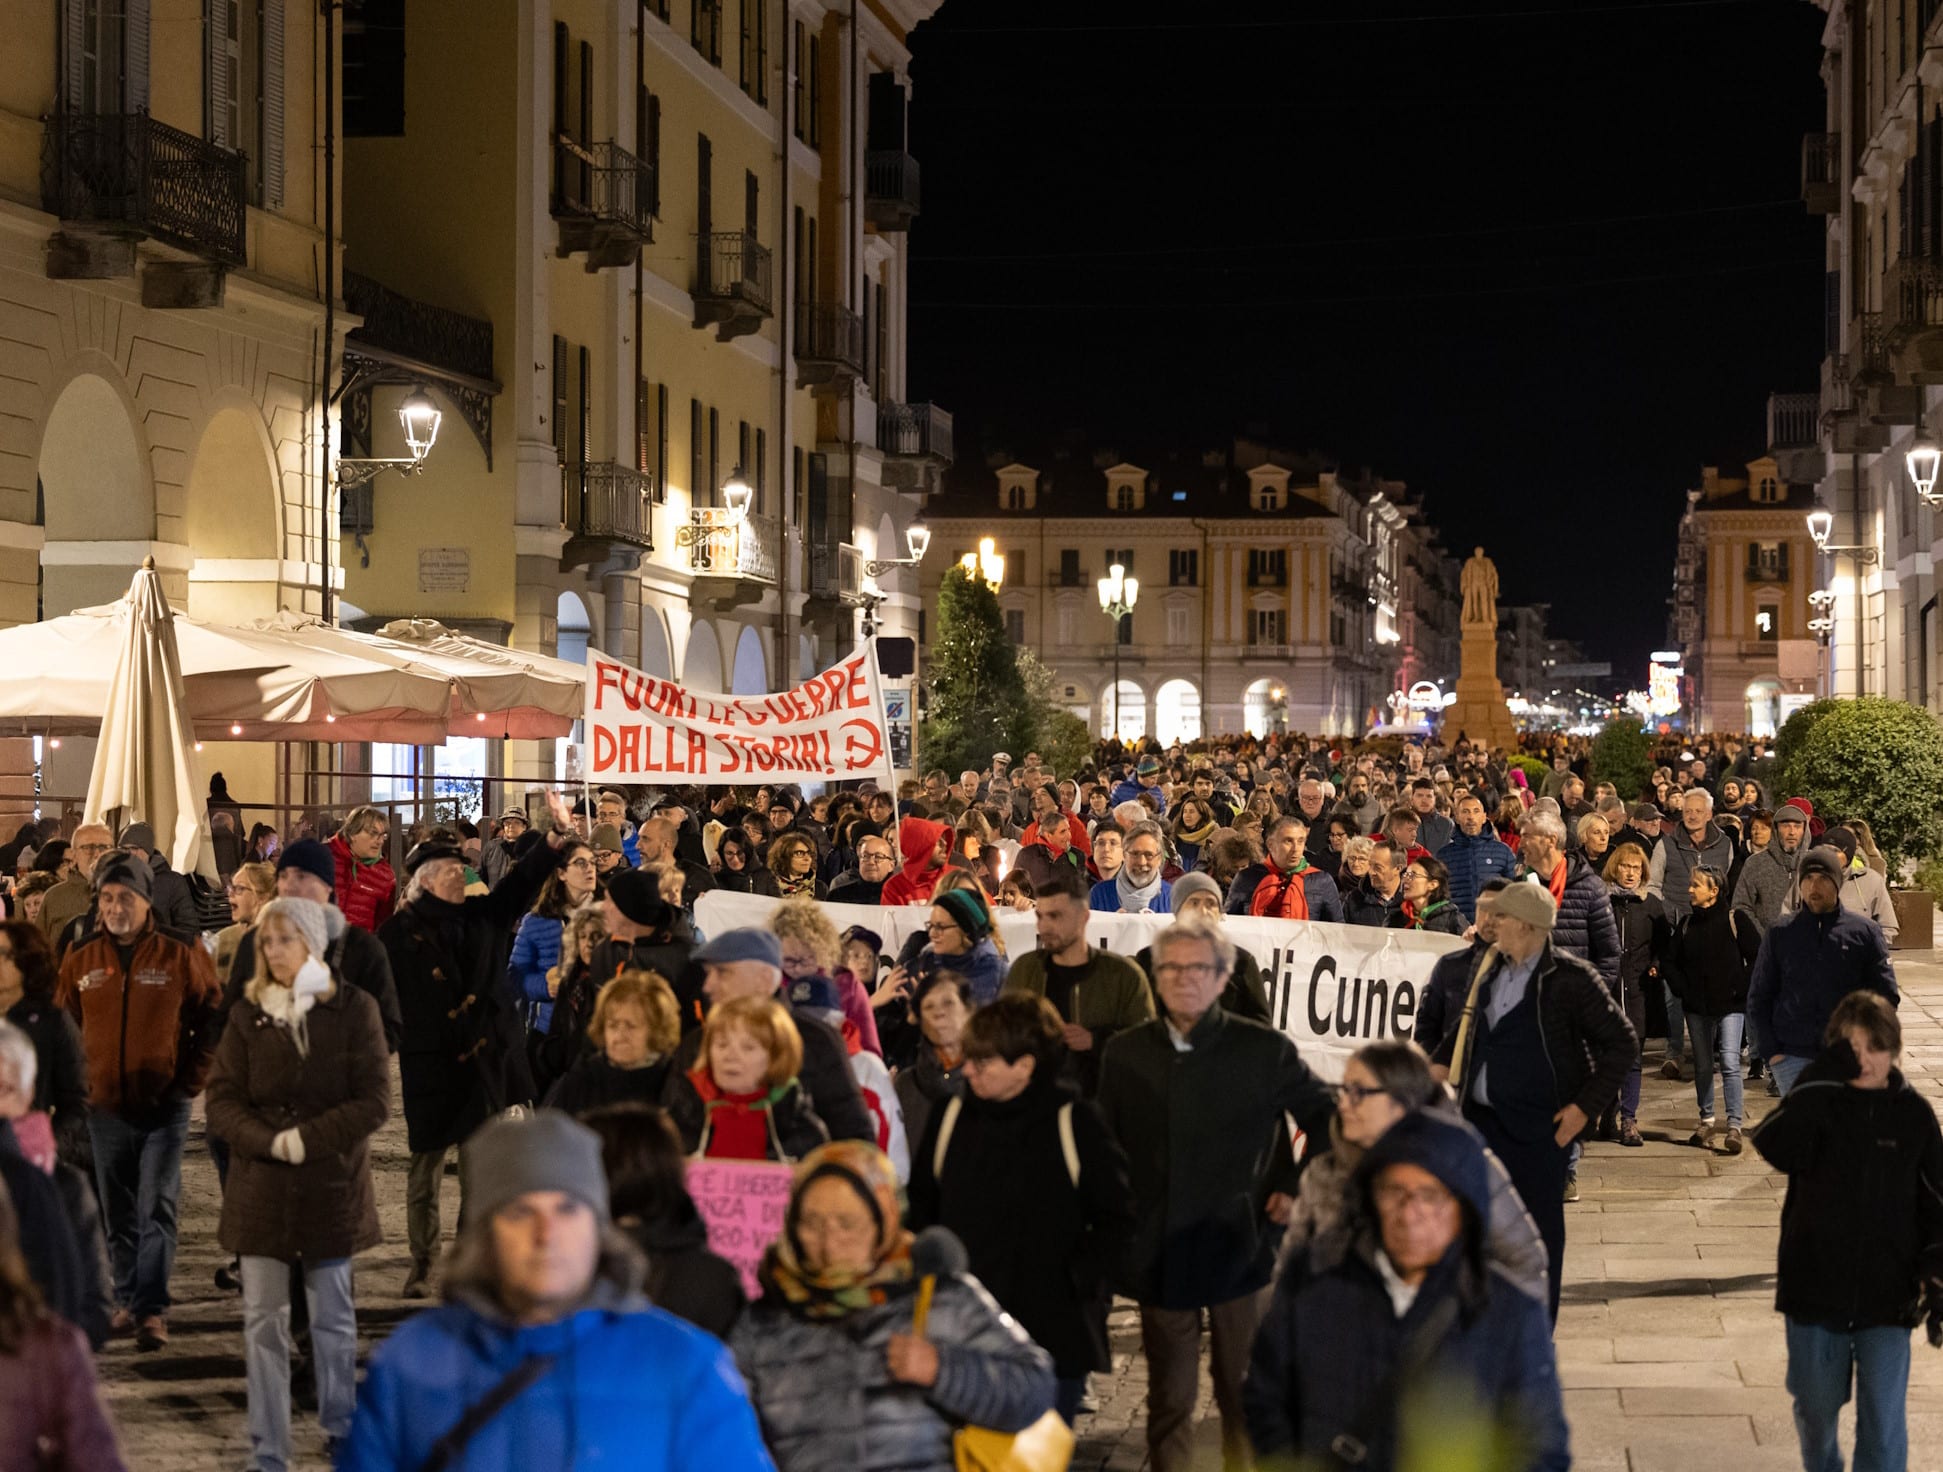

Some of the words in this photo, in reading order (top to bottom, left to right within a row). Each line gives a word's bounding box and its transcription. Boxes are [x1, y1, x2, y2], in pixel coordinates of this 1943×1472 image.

[707, 701, 736, 727] LE
[593, 724, 707, 775] DALLA
[714, 729, 836, 775] STORIA!
[1307, 954, 1418, 1041] Cune
